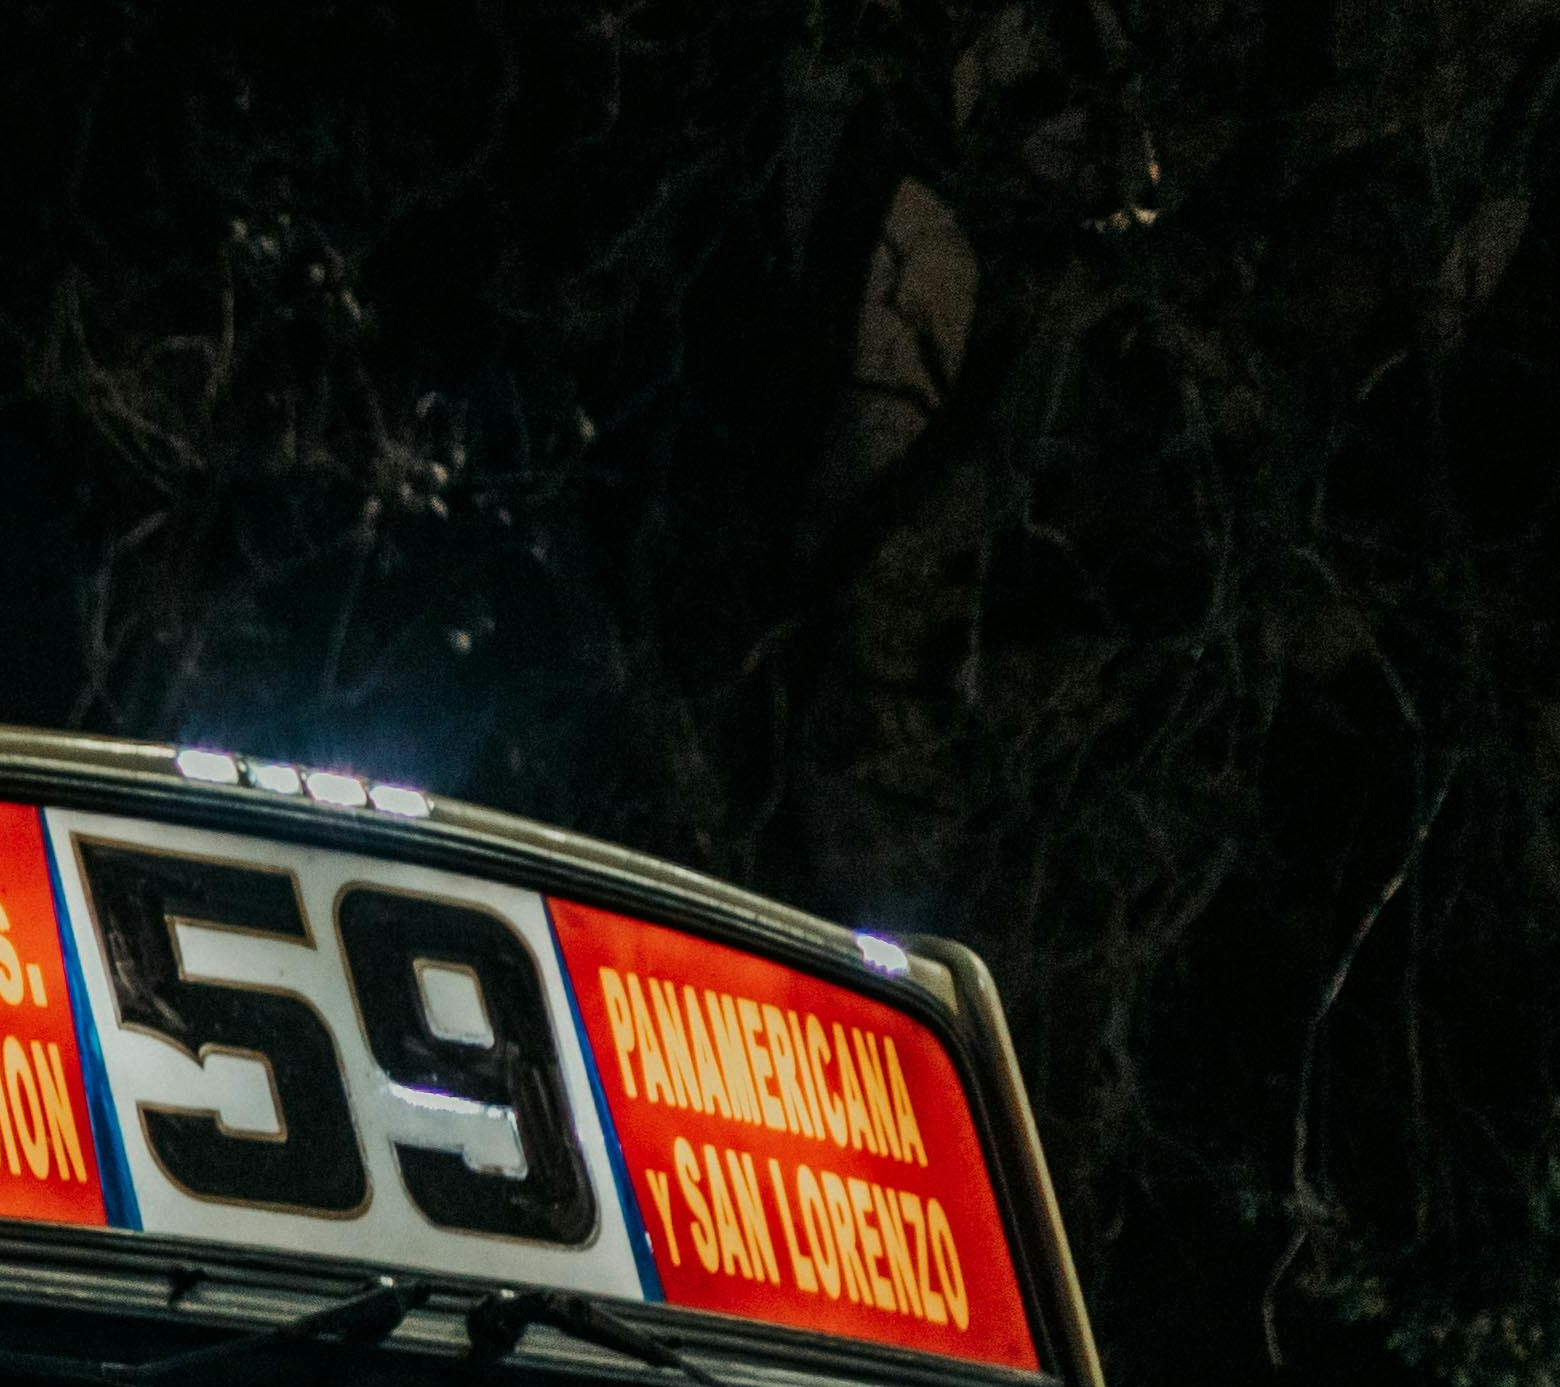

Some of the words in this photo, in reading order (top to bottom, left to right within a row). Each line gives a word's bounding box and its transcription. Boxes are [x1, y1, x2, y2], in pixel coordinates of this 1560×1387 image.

[69, 830, 600, 1253] 59
[597, 965, 930, 1168] PANAMERICANA
[672, 1135, 781, 1288] SAN
[767, 1156, 971, 1332] LORENZO
